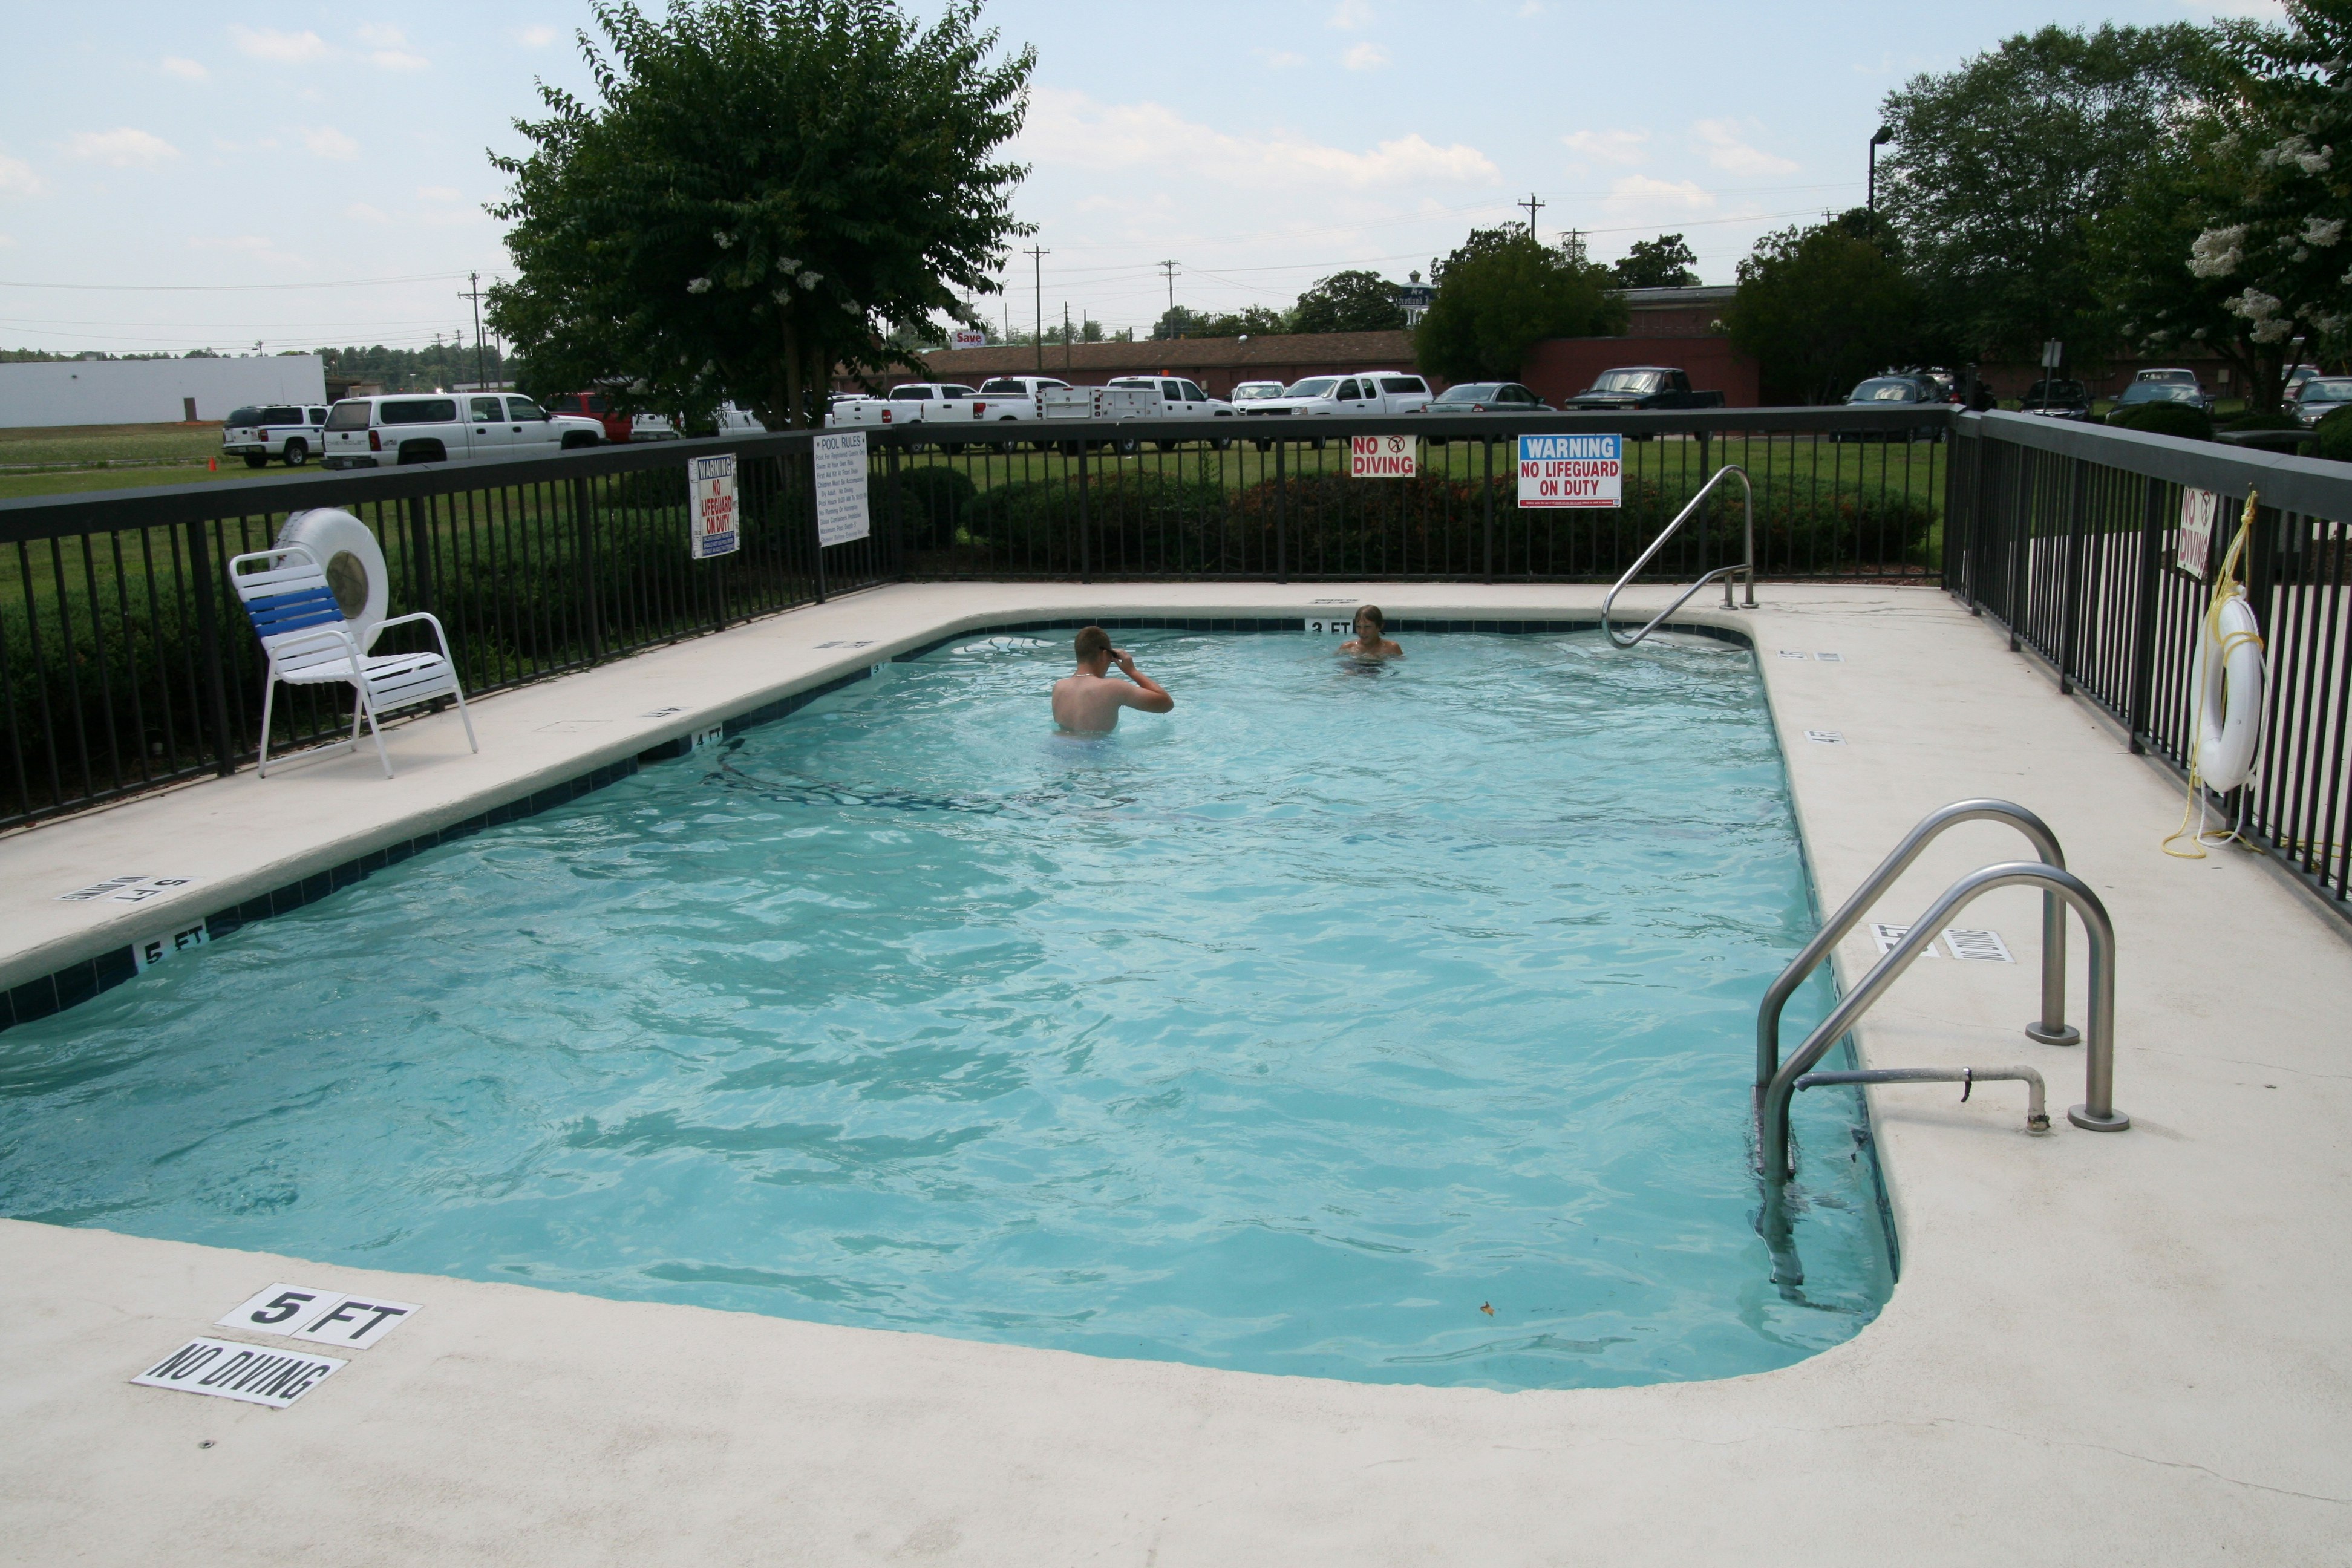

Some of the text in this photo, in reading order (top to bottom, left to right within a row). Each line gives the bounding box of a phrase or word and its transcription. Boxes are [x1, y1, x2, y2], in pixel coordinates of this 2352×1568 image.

[957, 332, 982, 342] Save
[822, 435, 861, 450] POOL RULES
[1353, 437, 1378, 455] NO
[1526, 437, 1613, 459] WARNING
[699, 458, 731, 479] WARNING
[1353, 457, 1413, 474] DIVING
[1521, 460, 1619, 478] NO LIFEGUARD
[712, 479, 721, 497] NO
[1540, 480, 1599, 496] ON DUTY
[701, 495, 732, 517] LIFEGUARD
[2182, 489, 2196, 526] NO
[706, 514, 730, 534] ON DUTY
[2179, 527, 2208, 572] DIVING
[1331, 622, 1351, 633] FT
[61, 884, 126, 900] DIVING
[113, 889, 163, 902] FT
[145, 925, 203, 964] 5 FT
[1947, 929, 2007, 962] NO DIVING
[250, 1291, 408, 1339] 5 FT
[146, 1342, 332, 1400] NO DIVING
